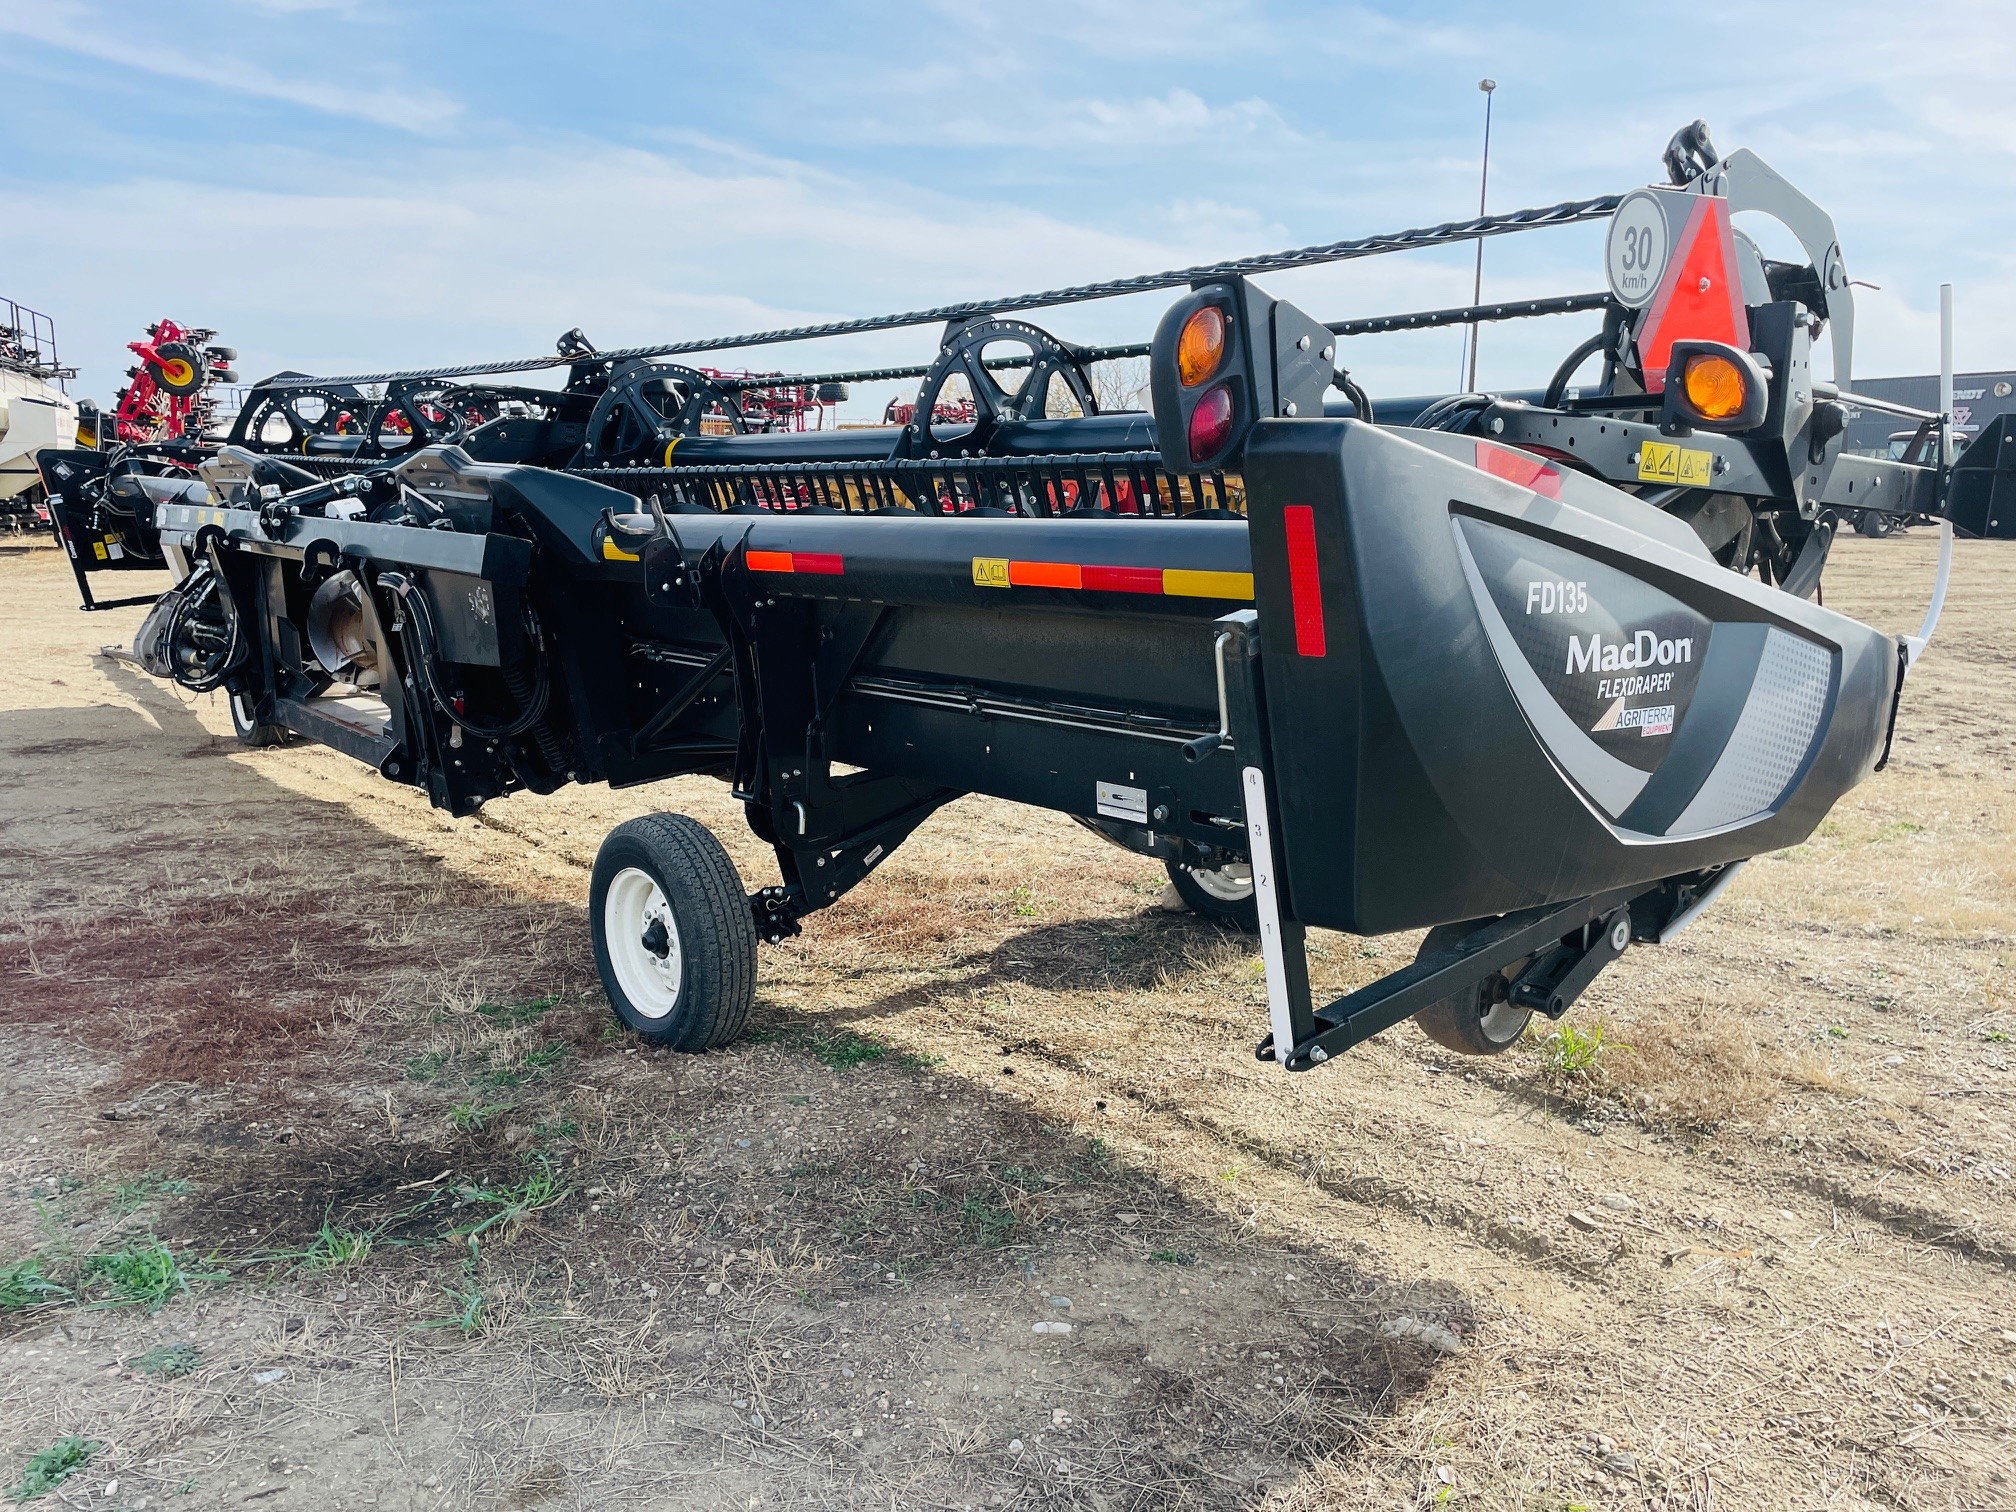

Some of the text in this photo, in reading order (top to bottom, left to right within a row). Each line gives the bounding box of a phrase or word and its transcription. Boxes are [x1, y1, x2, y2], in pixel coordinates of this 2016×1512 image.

[1622, 226, 1652, 271] 30
[1622, 273, 1647, 289] km/h
[1526, 581, 1588, 615] FD135
[1565, 630, 1692, 675] MacDon
[1597, 672, 1672, 700] FLEXDRAPER
[1616, 707, 1673, 728] AGRITERRA
[1642, 724, 1673, 736] EQUIPMENT
[1255, 824, 1261, 837] 3
[1260, 874, 1268, 887] 2
[1266, 923, 1271, 935] 1
